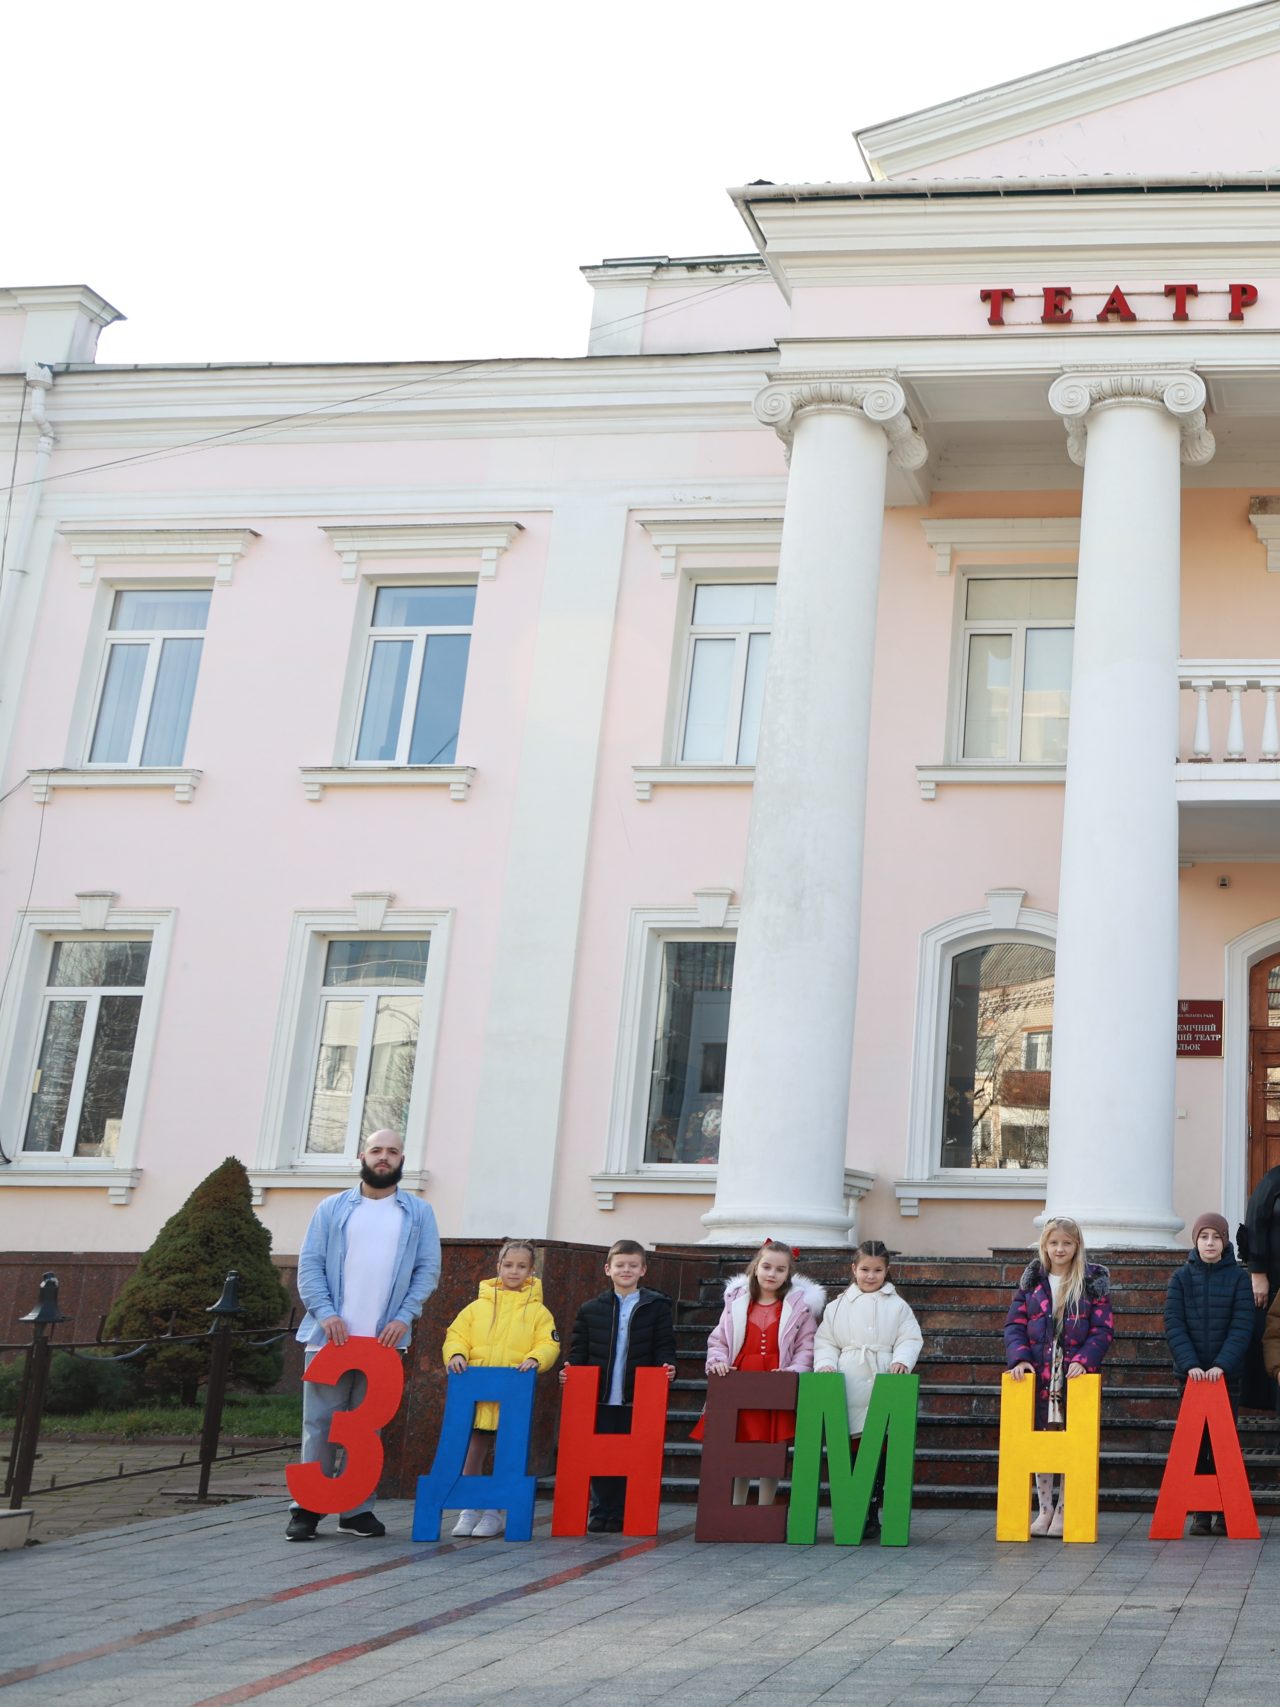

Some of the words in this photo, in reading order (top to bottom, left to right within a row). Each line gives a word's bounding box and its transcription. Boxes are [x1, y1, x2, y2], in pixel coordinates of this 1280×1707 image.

[980, 283, 1258, 326] ТЕАТР
[286, 1335, 404, 1514] З
[411, 1365, 920, 1546] ДНЕМ
